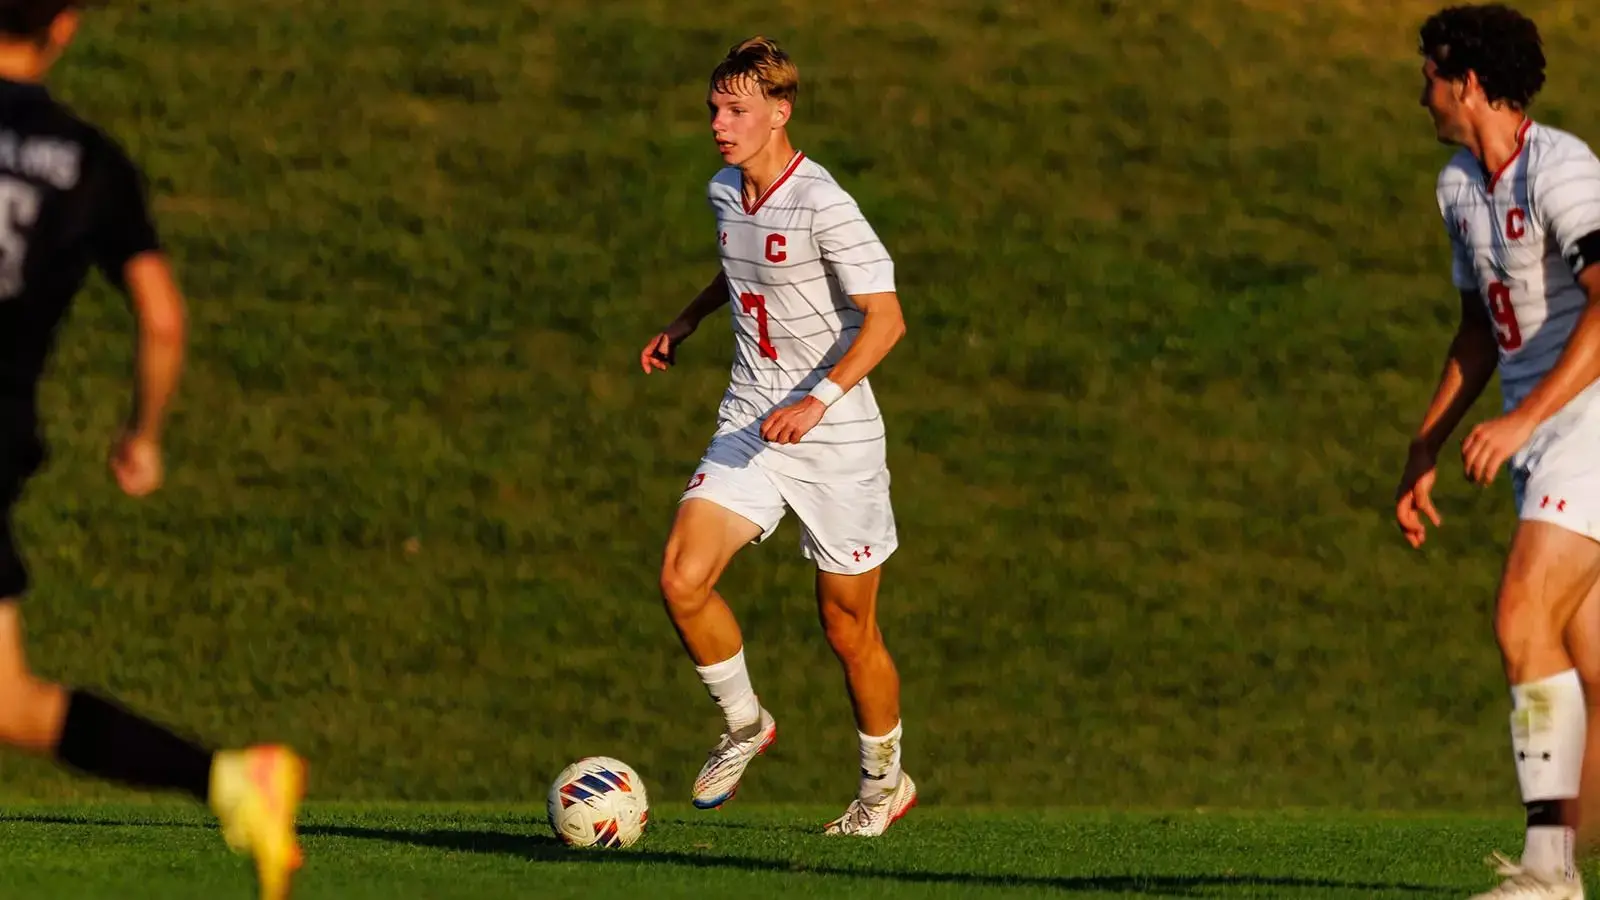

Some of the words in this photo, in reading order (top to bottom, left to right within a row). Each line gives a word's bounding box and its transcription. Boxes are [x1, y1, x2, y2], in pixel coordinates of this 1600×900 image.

[765, 233, 787, 263] C
[1505, 207, 1526, 240] C
[740, 293, 778, 360] 7
[1488, 281, 1522, 351] 9
